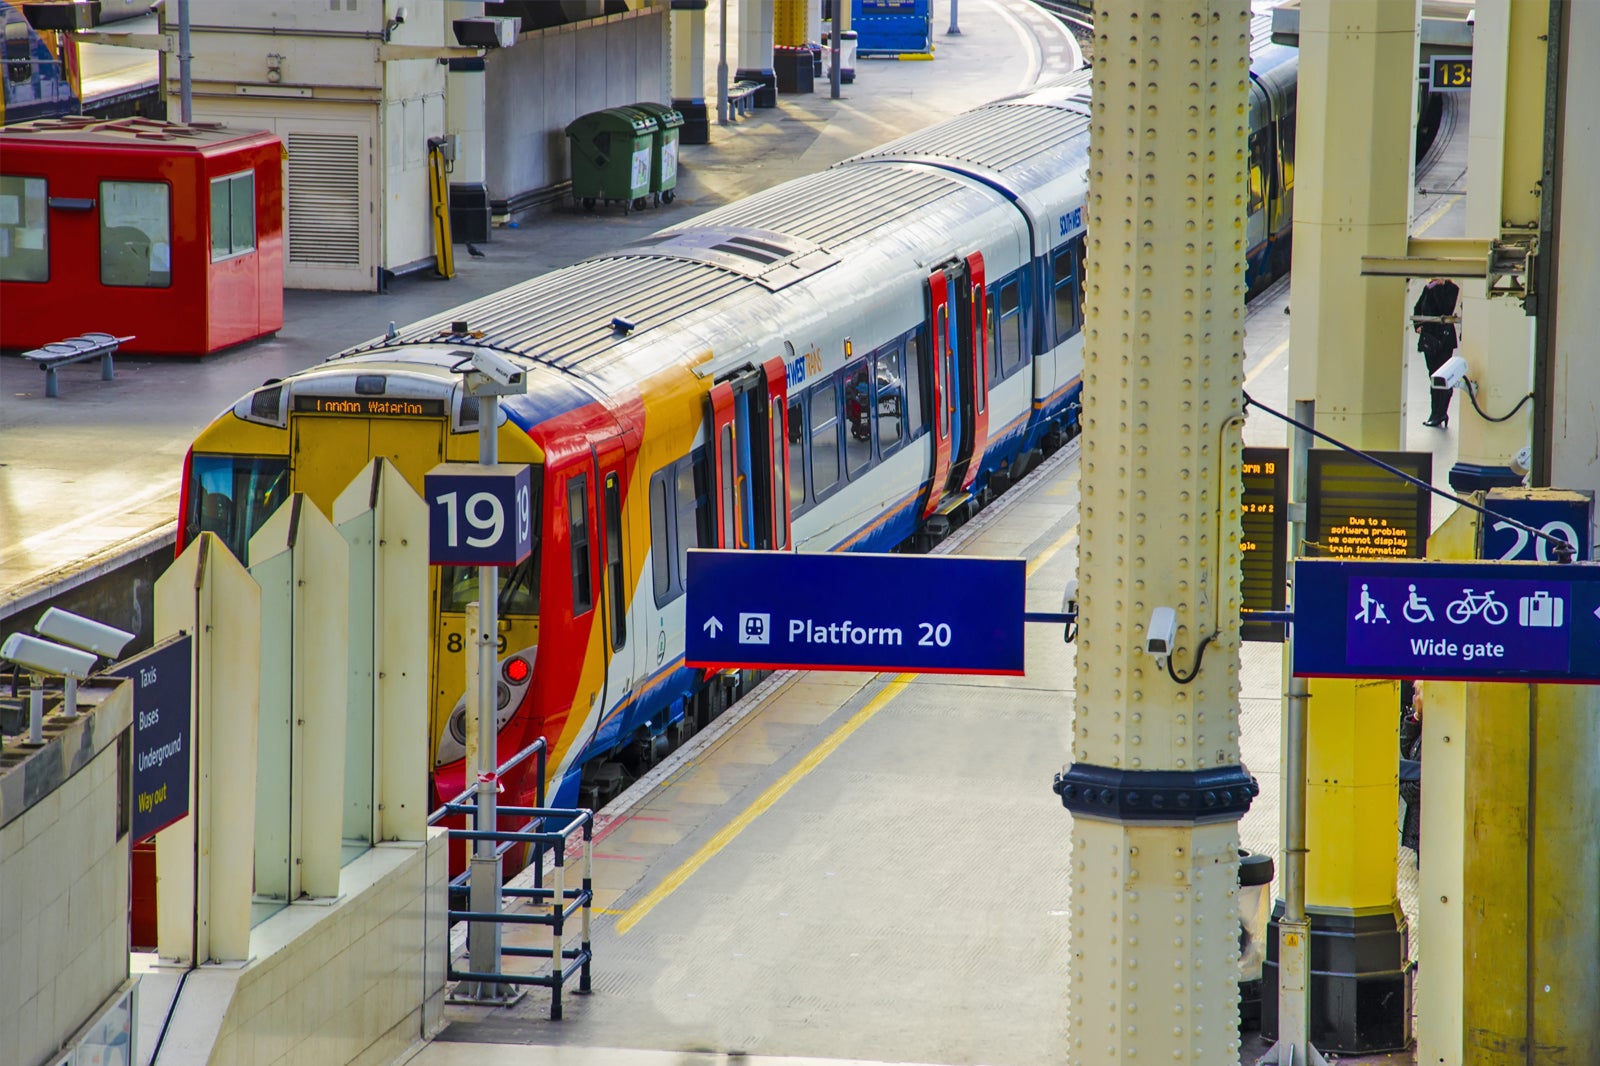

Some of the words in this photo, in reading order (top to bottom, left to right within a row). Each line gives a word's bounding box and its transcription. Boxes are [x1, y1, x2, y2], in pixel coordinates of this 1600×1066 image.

[1440, 63, 1471, 85] 13:
[1264, 462, 1275, 474] 19
[436, 491, 505, 548] 19
[516, 484, 529, 544] 19
[1250, 504, 1256, 512] 2
[1257, 504, 1267, 512] of
[1268, 504, 1274, 513] 2
[1331, 526, 1369, 535] software
[1371, 527, 1406, 536] problem
[1349, 516, 1365, 526] Due
[1368, 517, 1378, 526] to
[1329, 544, 1353, 553] train
[1356, 545, 1407, 555] information
[1342, 536, 1371, 545] cannot
[1374, 537, 1407, 547] display
[1492, 520, 1580, 561] 20
[447, 632, 508, 654] 89
[788, 619, 903, 646] Platform
[917, 622, 952, 647] 20
[1410, 638, 1458, 656] Wide
[1462, 641, 1505, 661] gate
[139, 666, 157, 689] Taxis
[139, 707, 159, 731] Buses
[138, 732, 182, 772] Underground
[138, 791, 154, 813] Way
[154, 783, 167, 805] out
